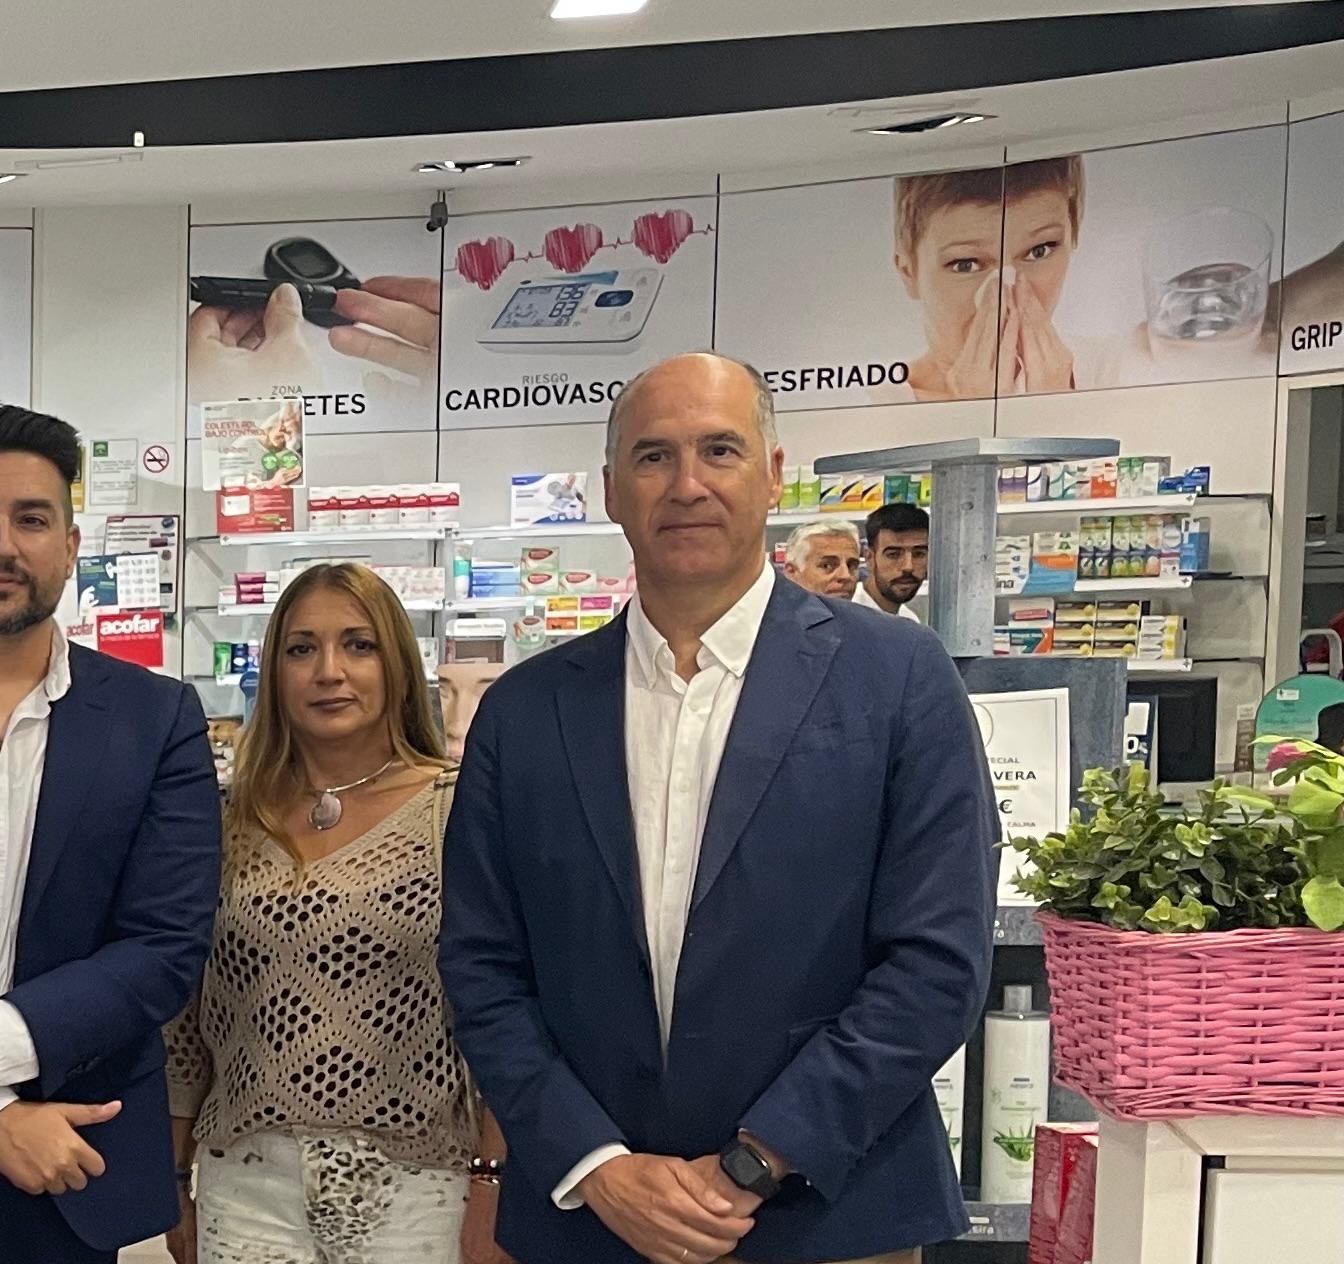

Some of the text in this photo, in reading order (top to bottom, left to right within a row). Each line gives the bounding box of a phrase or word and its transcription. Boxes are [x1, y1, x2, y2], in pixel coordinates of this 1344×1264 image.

[522, 372, 569, 385] RIESGO
[764, 361, 910, 393] ESFRIADO
[271, 385, 303, 396] ZONA
[100, 613, 161, 635] acofar
[994, 770, 1037, 781] VERA
